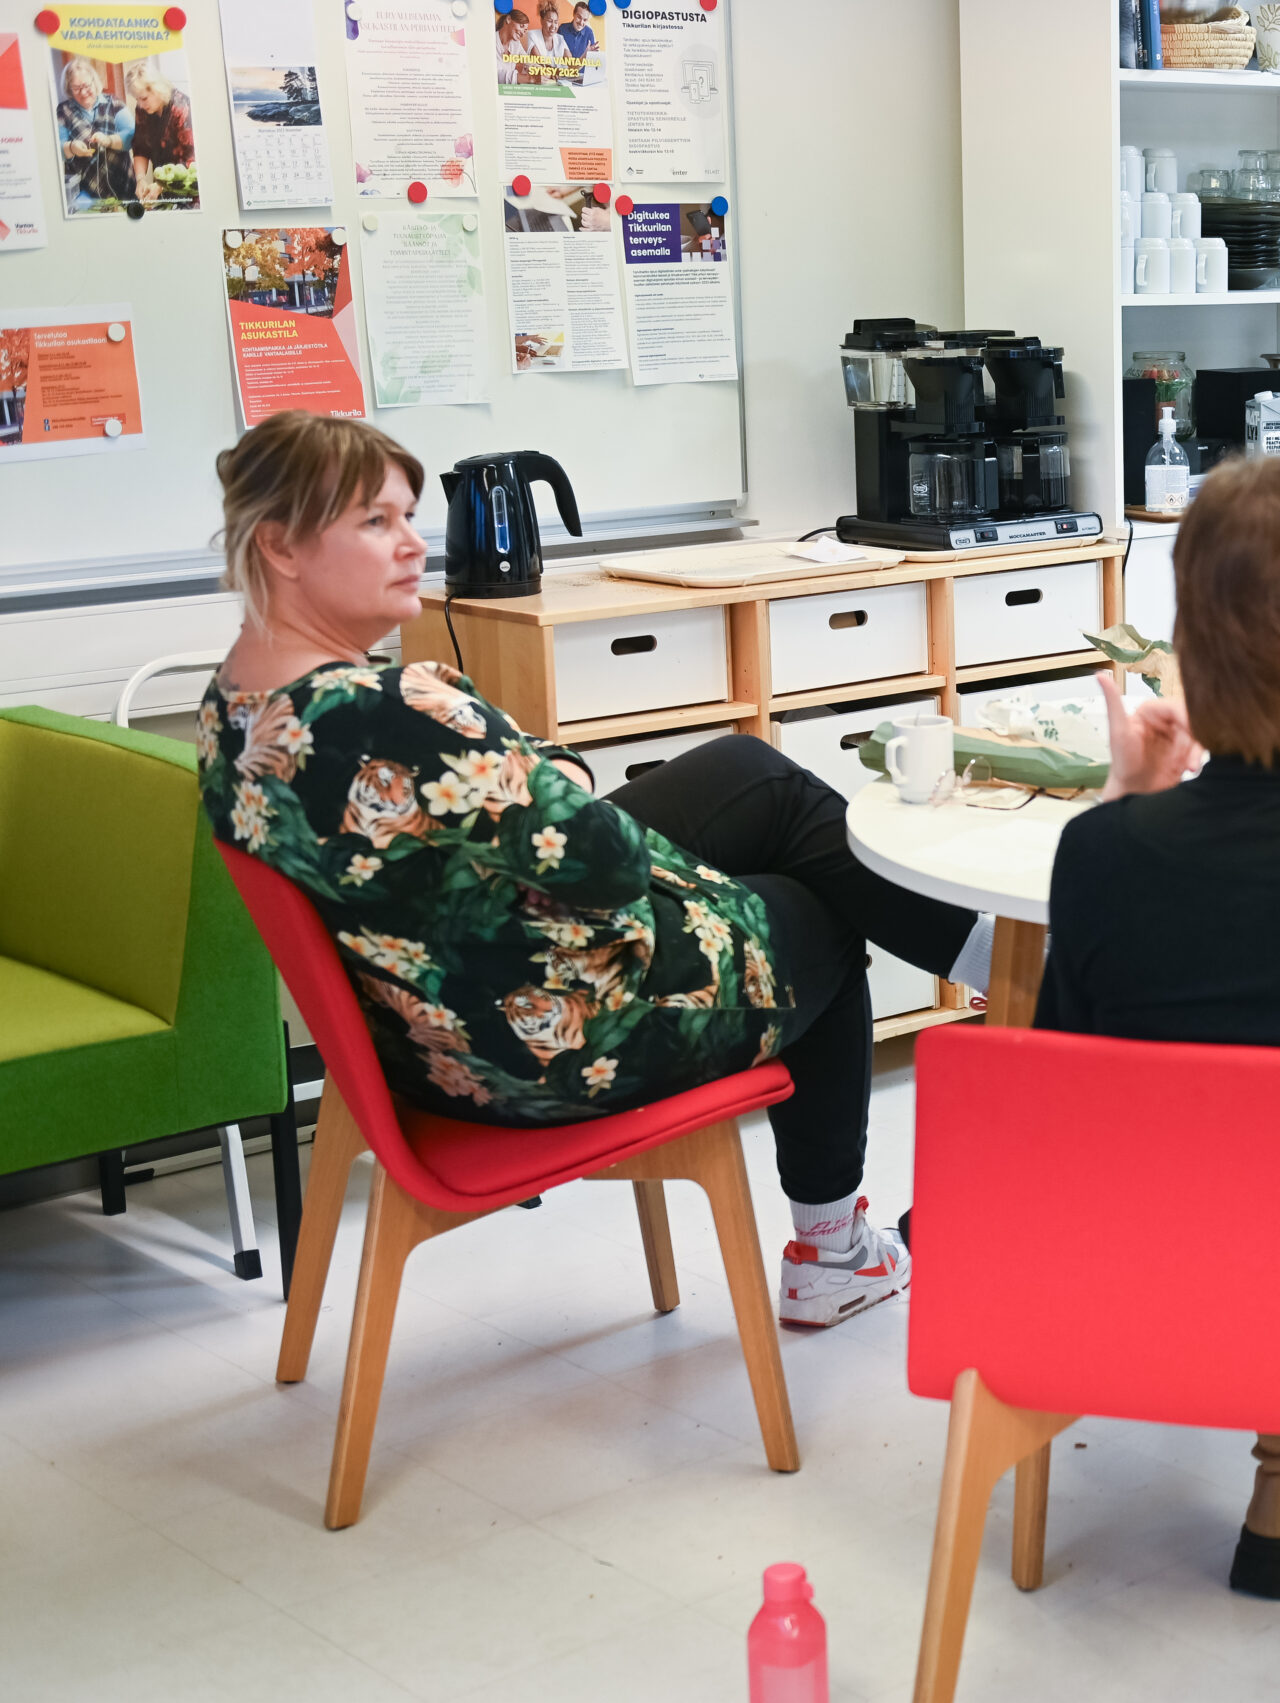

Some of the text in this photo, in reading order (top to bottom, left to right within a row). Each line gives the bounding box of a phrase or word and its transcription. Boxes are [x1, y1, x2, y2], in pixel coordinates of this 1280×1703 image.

[622, 10, 707, 23] DIGIOPASTUSTA
[69, 17, 159, 28] KOHDATAANKO
[61, 30, 170, 41] VAPAAEHTOISINA?
[503, 54, 602, 67] DIGITUKEA VANTAALLA
[529, 66, 580, 77] SYKSY 2023
[628, 211, 670, 222] Digitukea
[628, 223, 672, 232] Tikkurilan
[629, 236, 667, 246] terveys-
[630, 248, 671, 257] asemalla
[239, 320, 296, 330] TIKKURILAN
[241, 329, 299, 340] ASUKASTILA
[330, 409, 362, 417] Tikkurila
[1009, 531, 1046, 539] MOCCAMASTER
